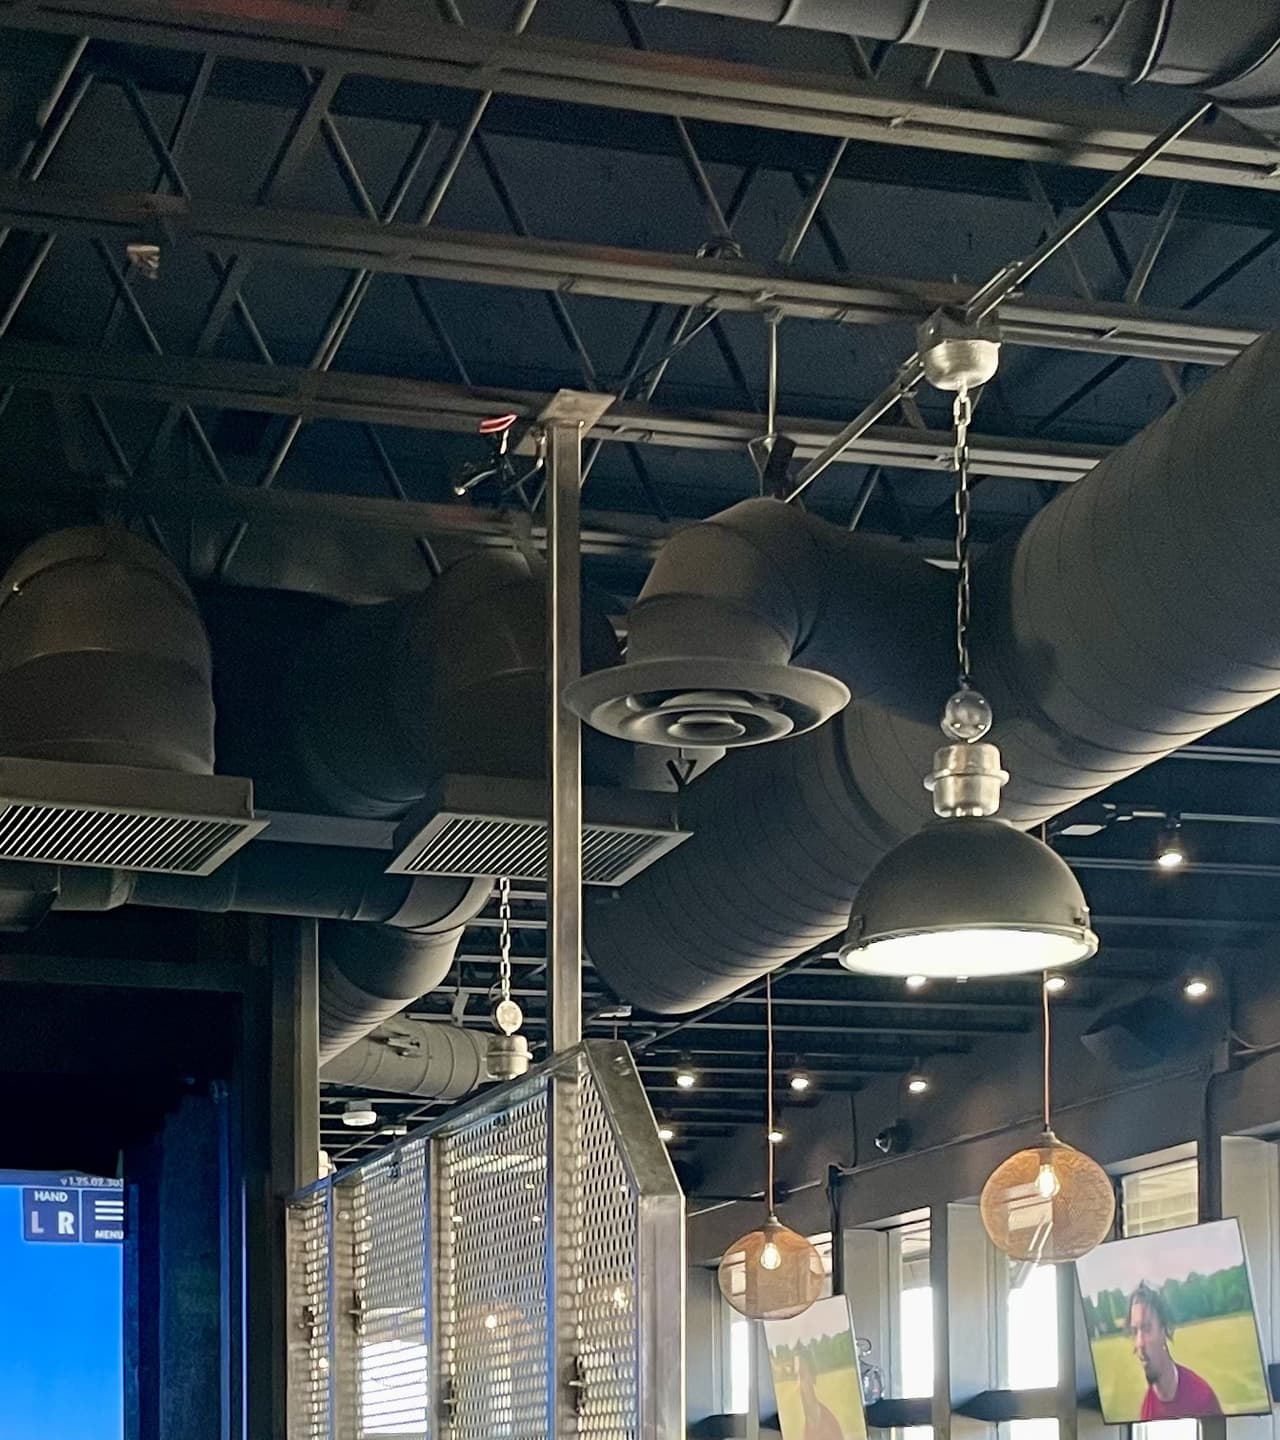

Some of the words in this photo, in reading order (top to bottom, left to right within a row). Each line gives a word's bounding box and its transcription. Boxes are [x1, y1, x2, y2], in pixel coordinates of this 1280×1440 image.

[34, 1191, 68, 1202] HAND
[31, 1211, 44, 1234] L
[58, 1211, 75, 1234] R
[94, 1230, 124, 1240] MENU
